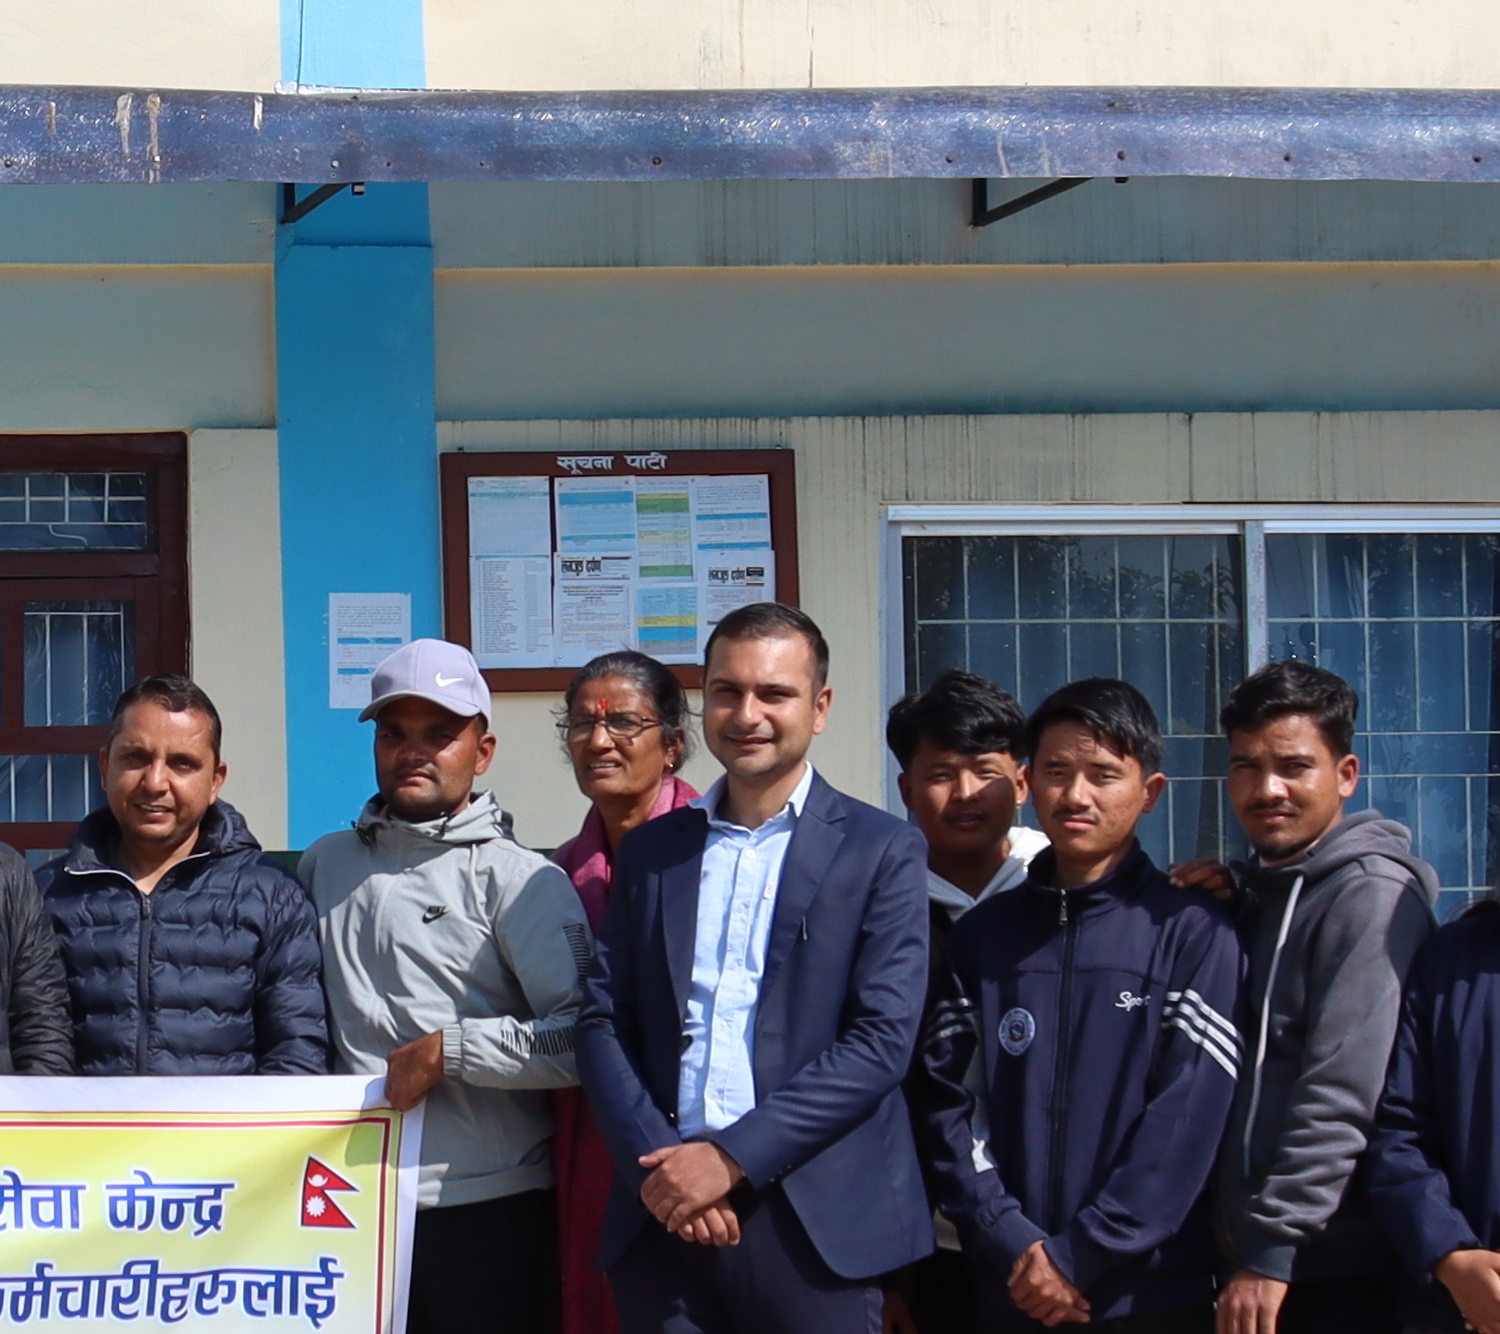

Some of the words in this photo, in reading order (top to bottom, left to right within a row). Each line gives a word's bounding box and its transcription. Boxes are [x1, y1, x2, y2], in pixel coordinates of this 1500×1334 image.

[556, 455, 615, 475] सूचना
[623, 452, 668, 470] पाटी
[106, 1169, 235, 1237] केन्द्र
